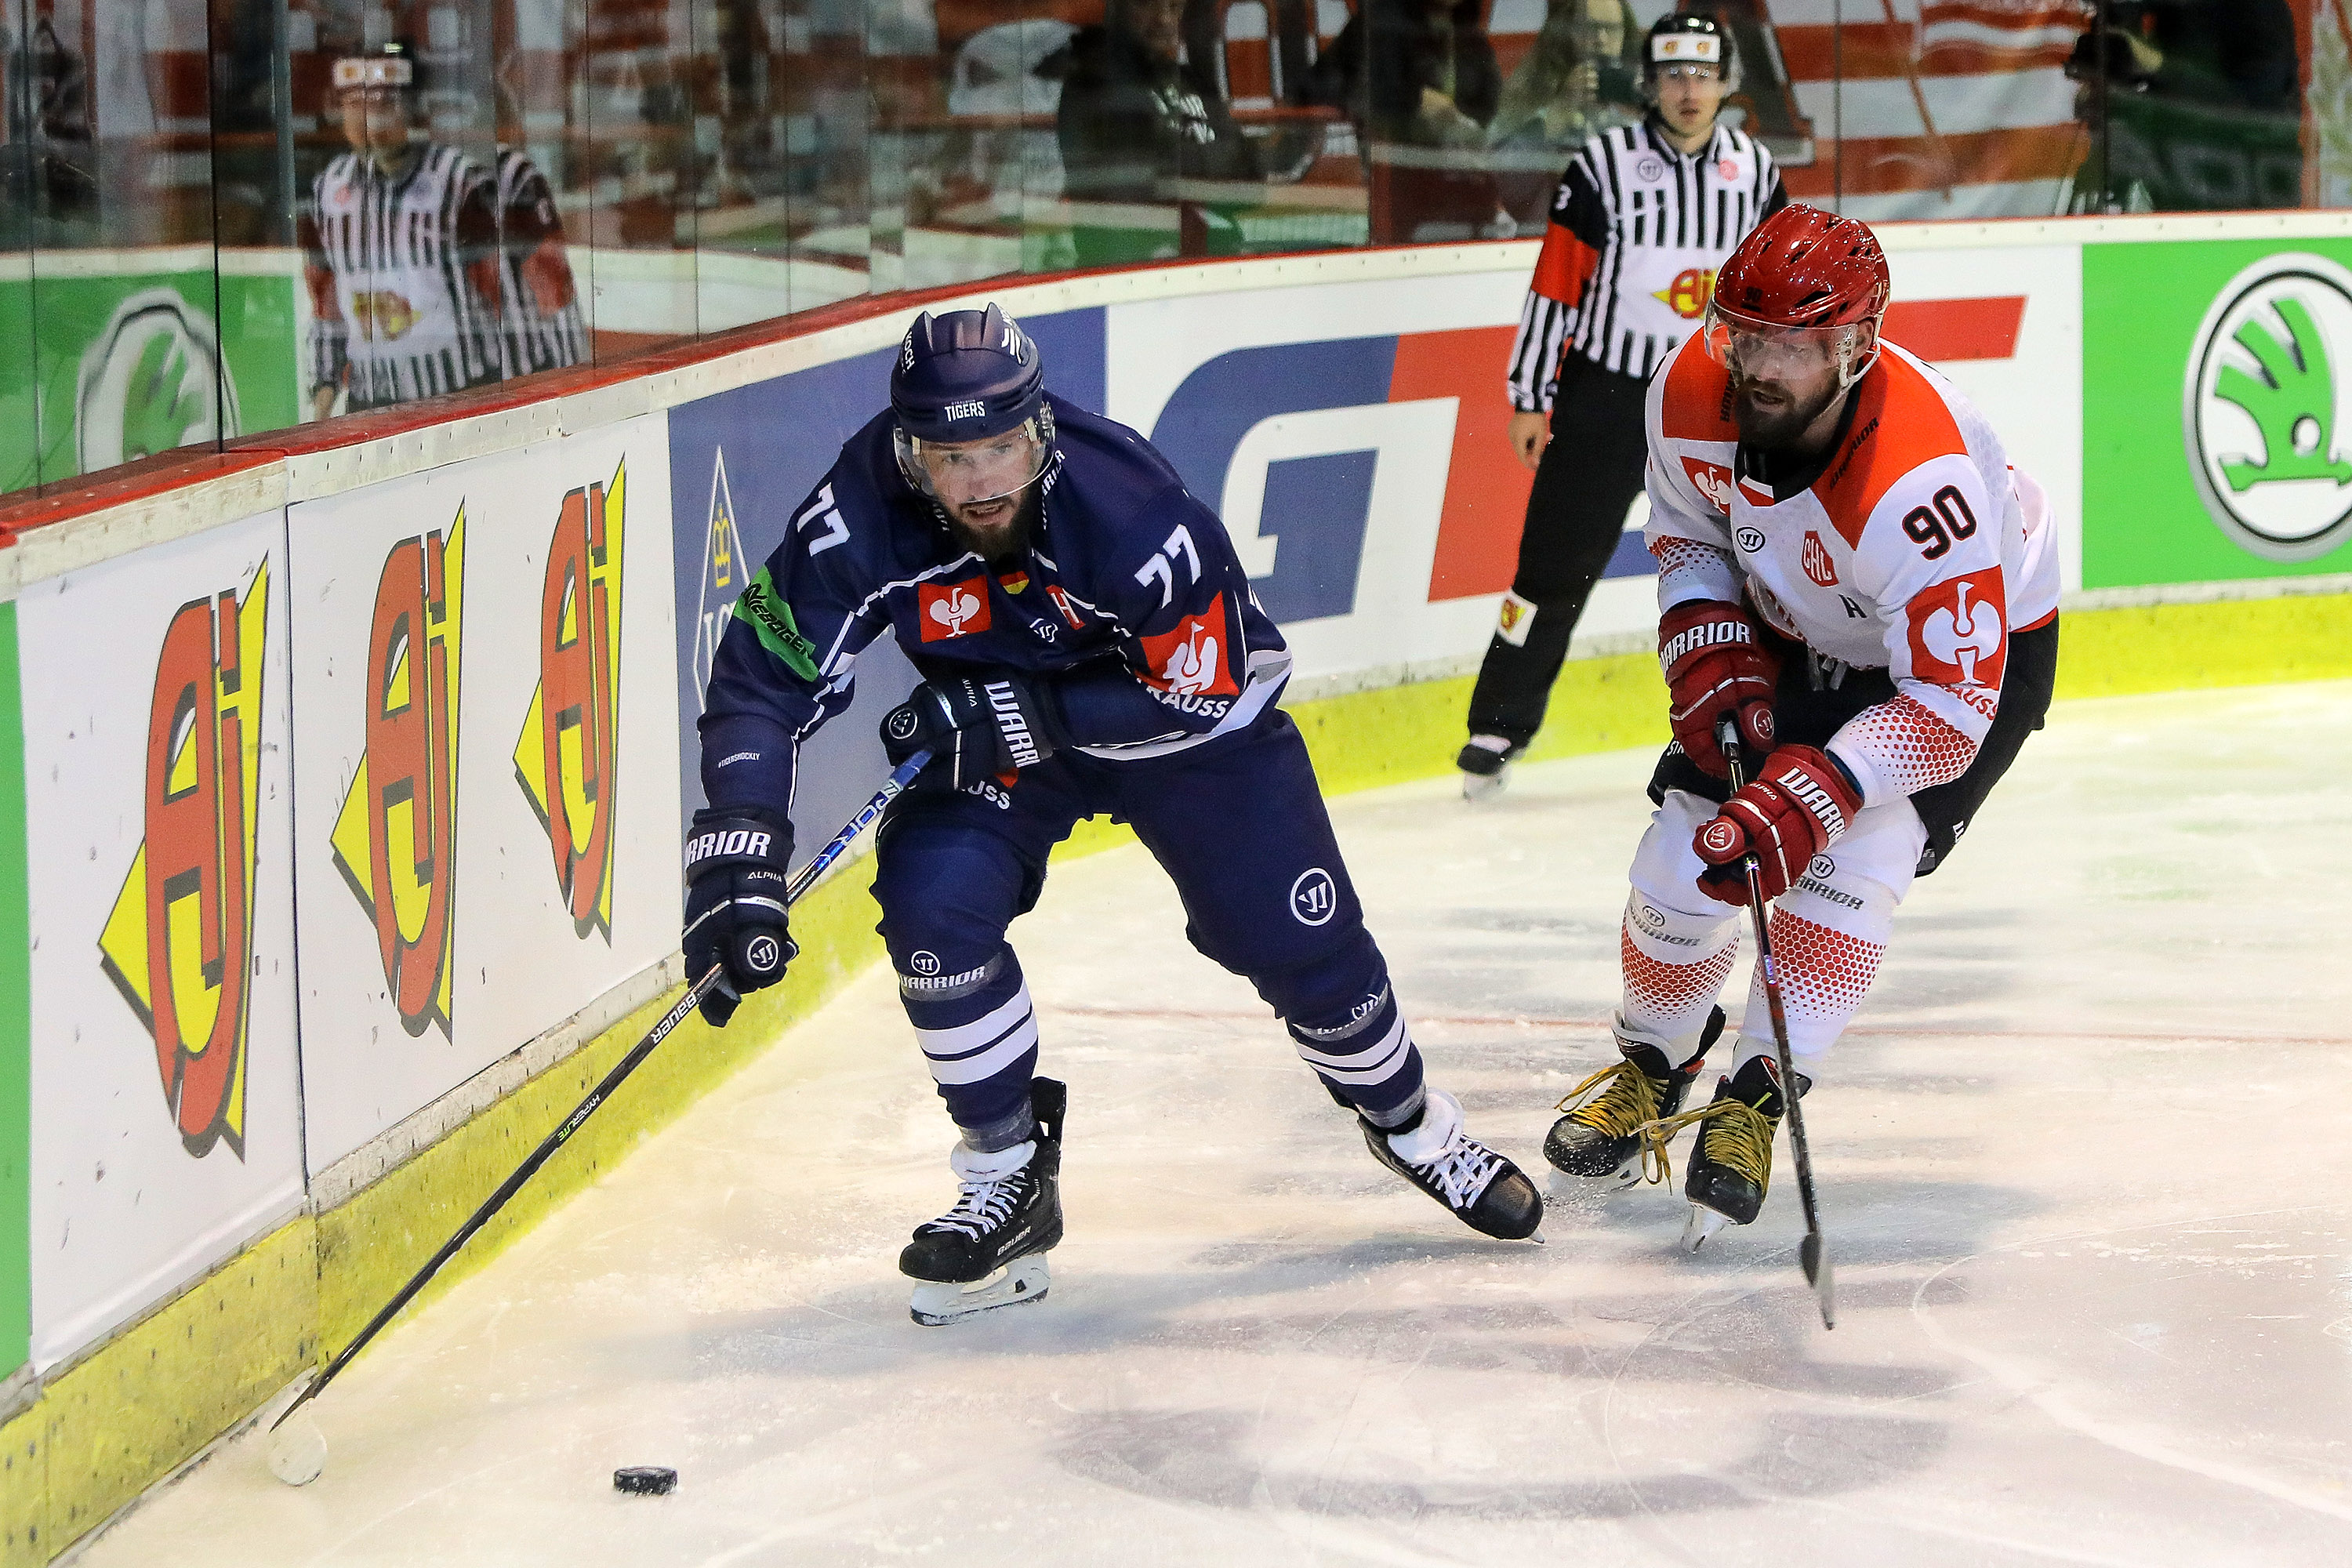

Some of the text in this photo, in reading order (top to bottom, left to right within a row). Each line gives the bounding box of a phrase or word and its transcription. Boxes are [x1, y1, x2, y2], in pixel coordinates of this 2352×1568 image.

[944, 401, 985, 422] TIGERS
[797, 481, 851, 557] 77
[1902, 485, 1977, 561] 90
[1134, 523, 1202, 609] 77
[1803, 537, 1833, 582] CHL
[983, 680, 1041, 768] WARR
[746, 870, 783, 884] ALPHA
[557, 1093, 601, 1142] HYPERLITE
